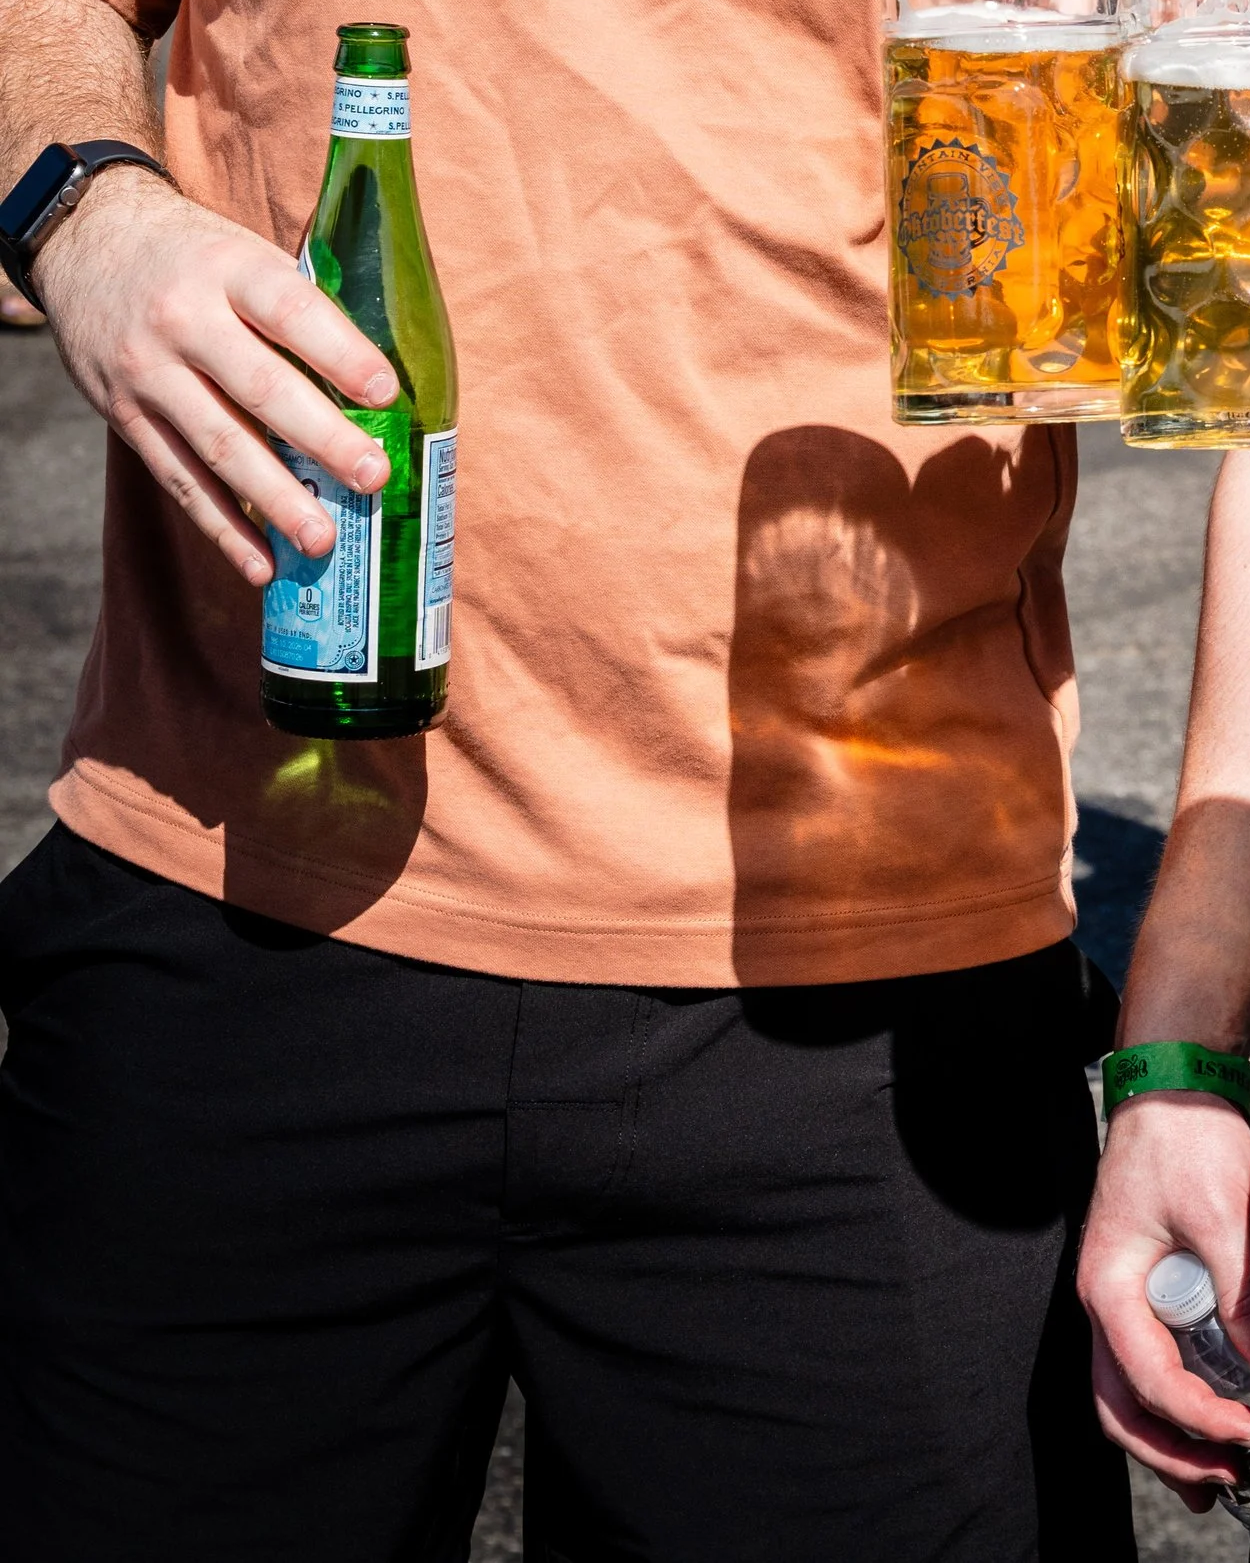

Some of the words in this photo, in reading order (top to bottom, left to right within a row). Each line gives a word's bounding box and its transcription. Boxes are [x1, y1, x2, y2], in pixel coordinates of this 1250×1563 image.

[338, 102, 405, 115] S.PELLEGRINO
[305, 587, 313, 603] 0
[299, 601, 320, 611] CALORIES
